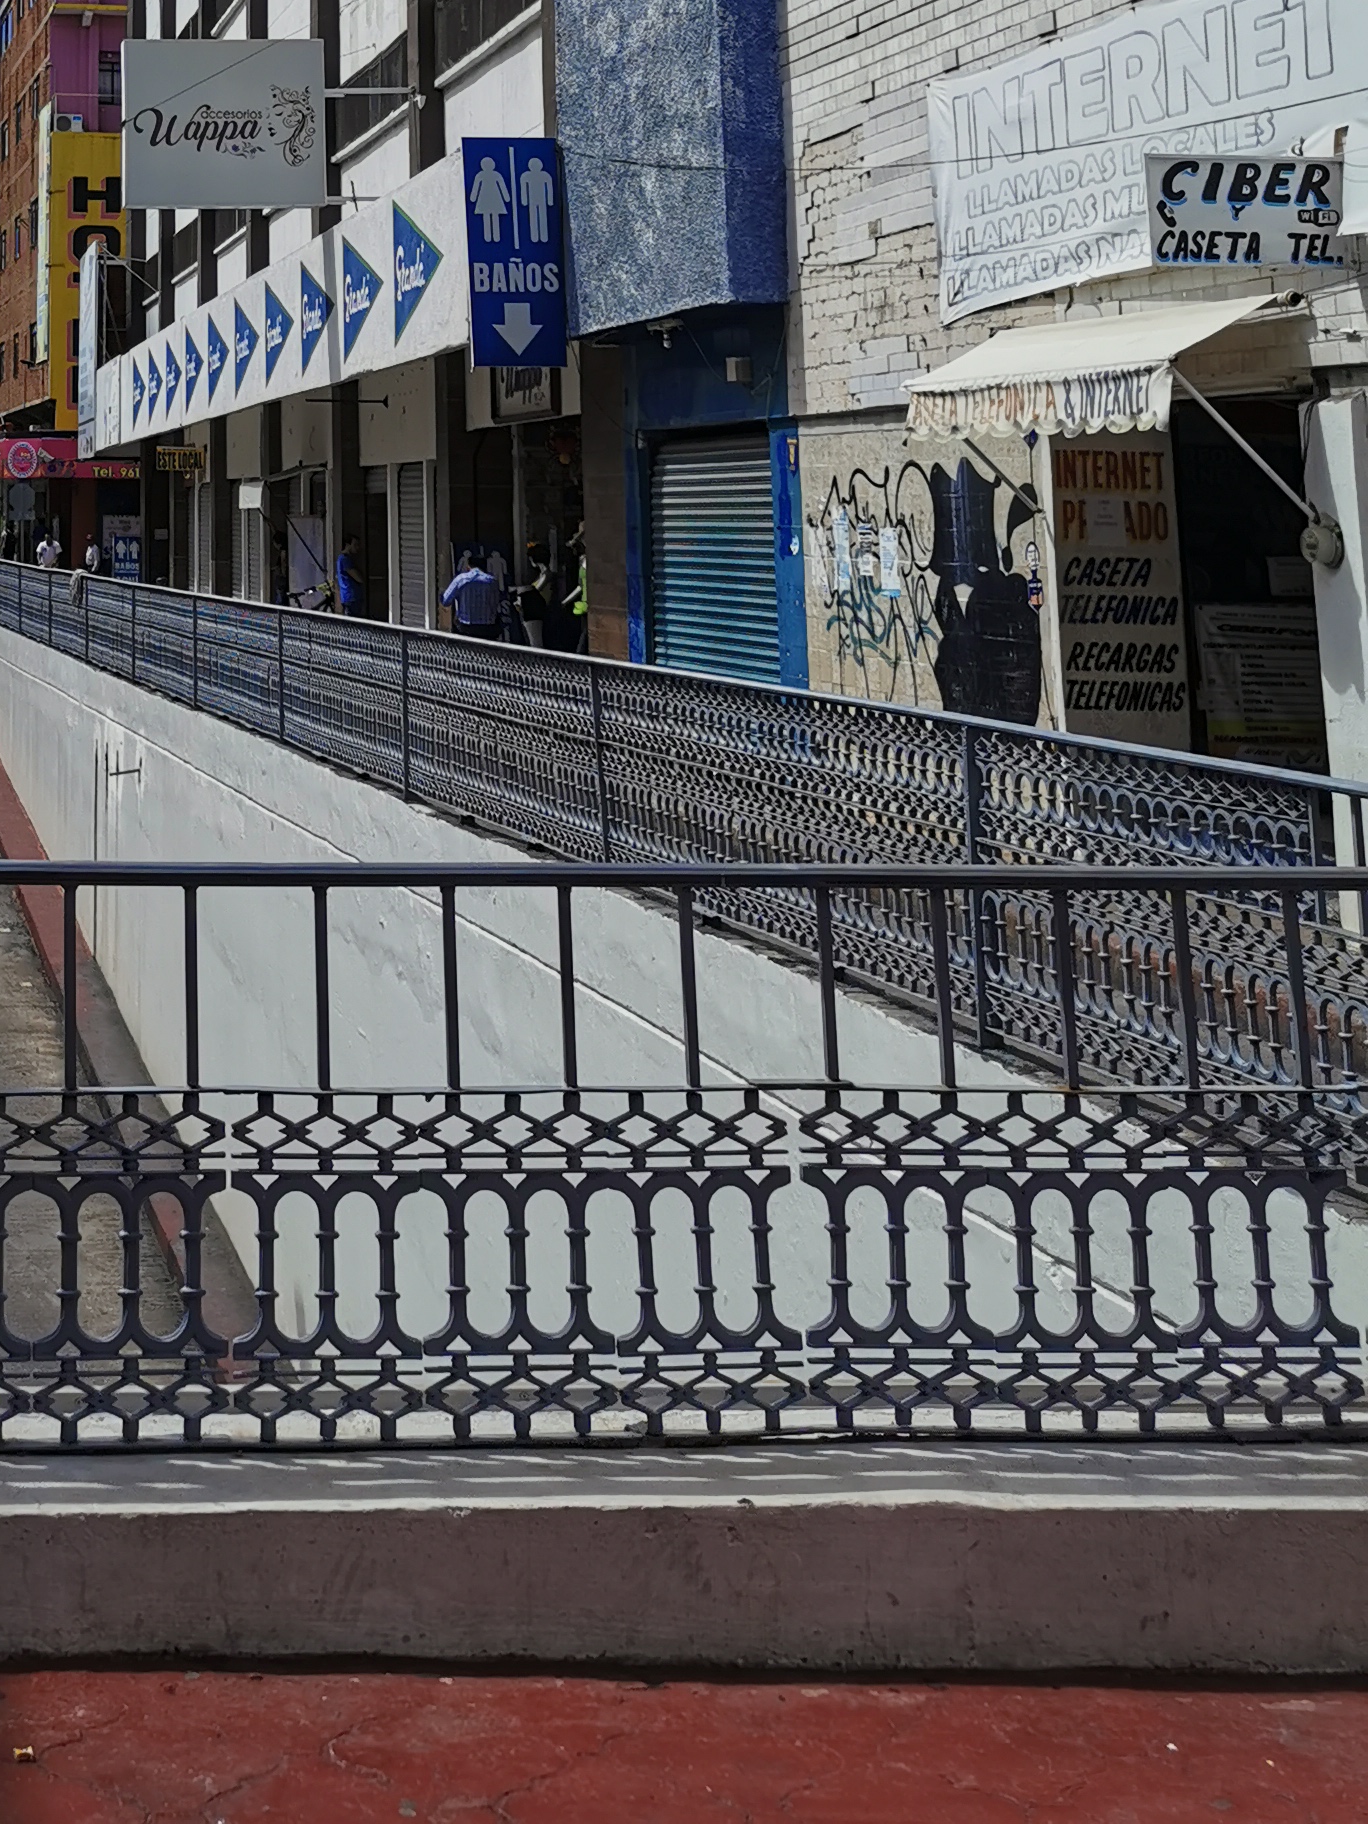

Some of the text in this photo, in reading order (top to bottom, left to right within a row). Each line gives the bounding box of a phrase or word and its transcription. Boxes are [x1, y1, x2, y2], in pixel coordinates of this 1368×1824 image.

[200, 108, 263, 120] accesorios
[966, 146, 1117, 220] LLAMADAS
[1160, 160, 1332, 209] CIBER
[954, 192, 1099, 263] LLAMADAS
[1156, 229, 1344, 266] CASETA TEL.
[472, 257, 560, 293] BAÑOS
[946, 240, 1093, 308] LLAMADAS
[1078, 365, 1155, 421] INTERNET
[157, 449, 204, 470] ESTE LOCAL
[1053, 448, 1165, 491] INTERNET
[1063, 556, 1152, 588] CASETA
[1059, 593, 1180, 626] TELEFONICA
[1065, 641, 1180, 674] RECARGAS
[1064, 678, 1187, 713] TELEFONICAS
